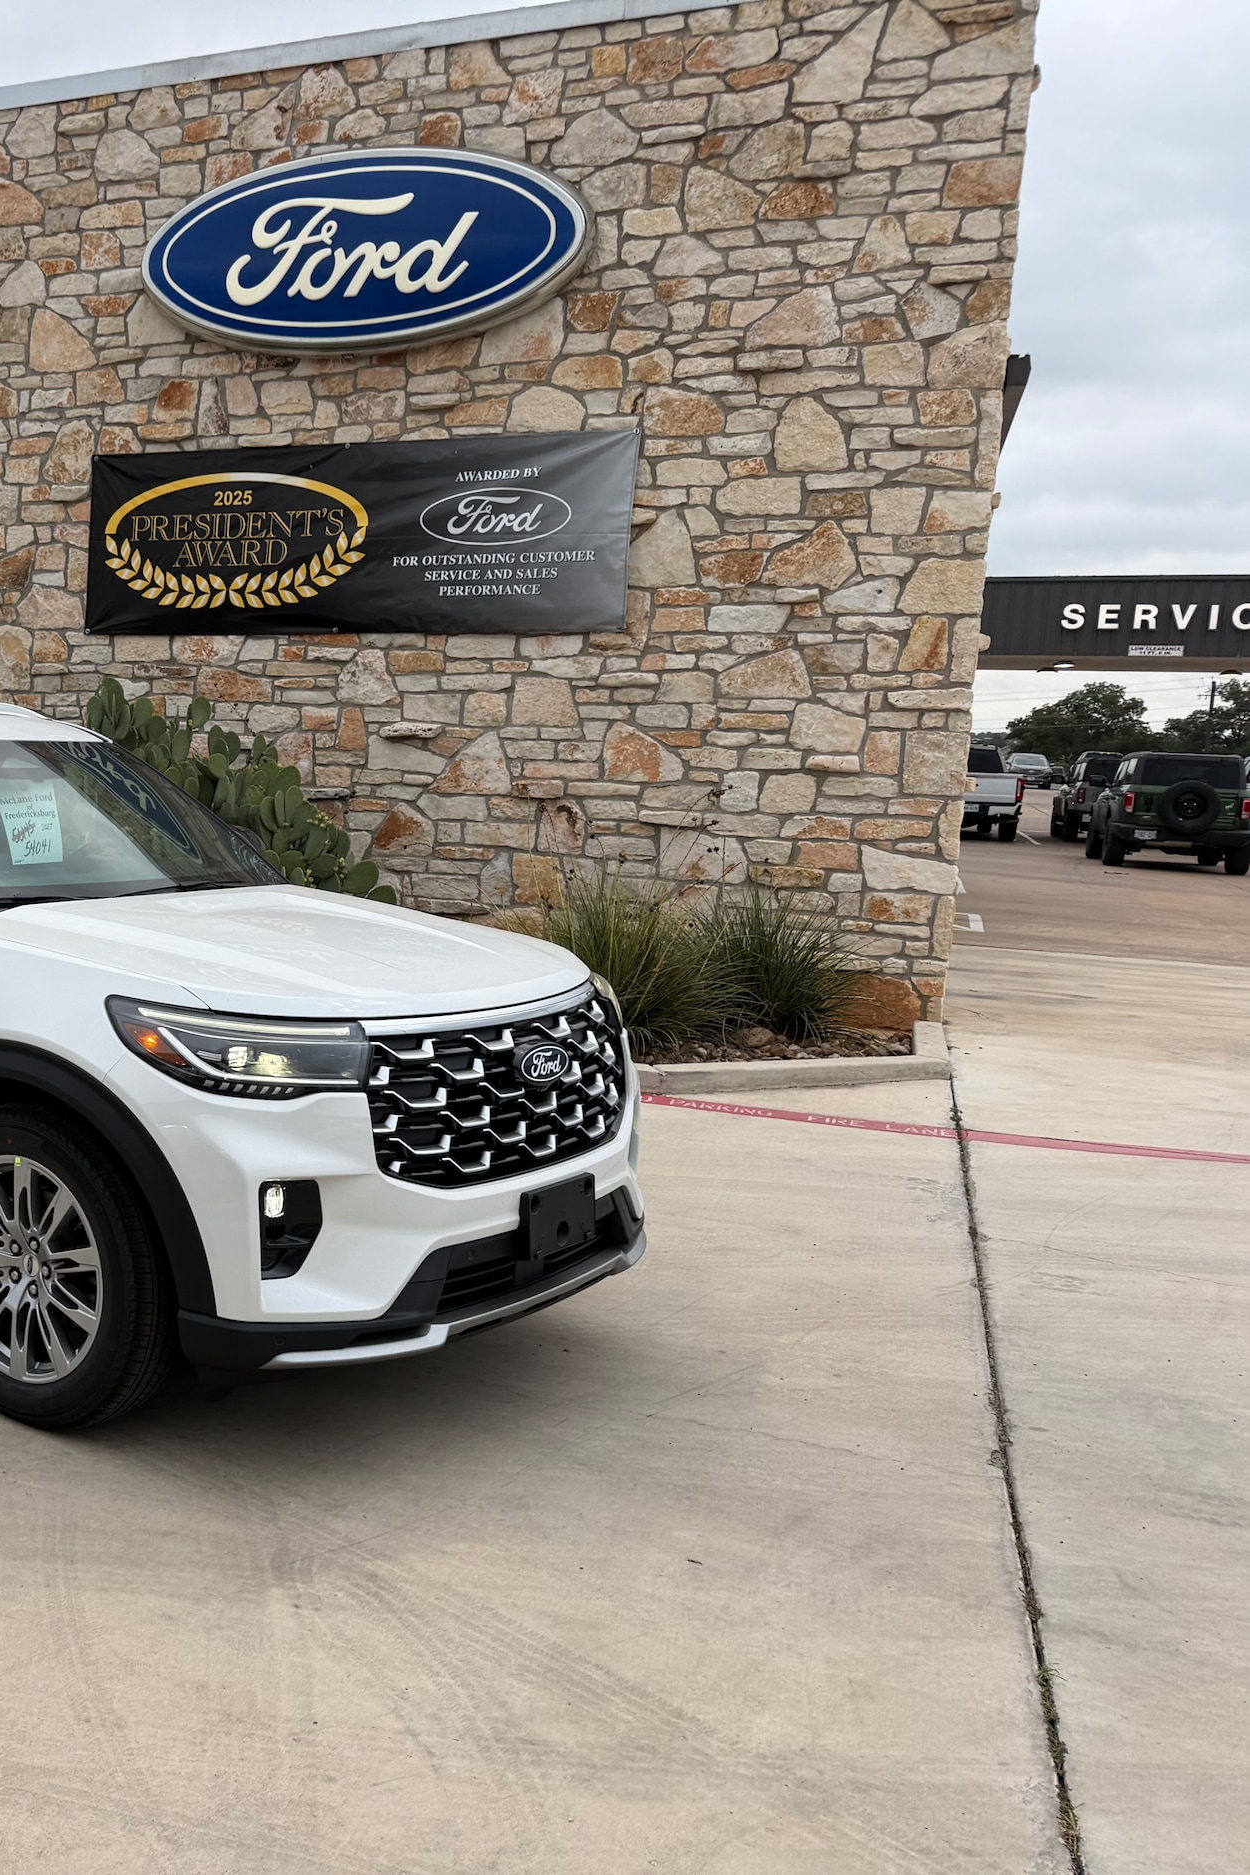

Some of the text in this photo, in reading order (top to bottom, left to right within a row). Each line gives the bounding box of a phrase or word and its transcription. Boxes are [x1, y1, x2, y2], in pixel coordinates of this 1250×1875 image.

[225, 192, 480, 306] Ford
[455, 466, 542, 483] AWARDED BY
[213, 490, 253, 506] 2025
[446, 495, 543, 535] Ford
[130, 508, 344, 542] PRESIDENT'S
[171, 539, 288, 568] AWARD
[392, 550, 596, 567] FOR OUTSTANDING CUSTOMER
[424, 567, 558, 581] SERVICE AND SALES
[439, 584, 541, 596] PERFORMANCE
[0, 792, 53, 805] McLane Ford
[4, 809, 56, 819] Fredericksburg
[23, 838, 51, 857] 54041
[531, 1051, 561, 1077] Ford
[669, 1098, 773, 1117] PARKING
[807, 1115, 865, 1128] FIRE
[885, 1124, 958, 1138] LANE
